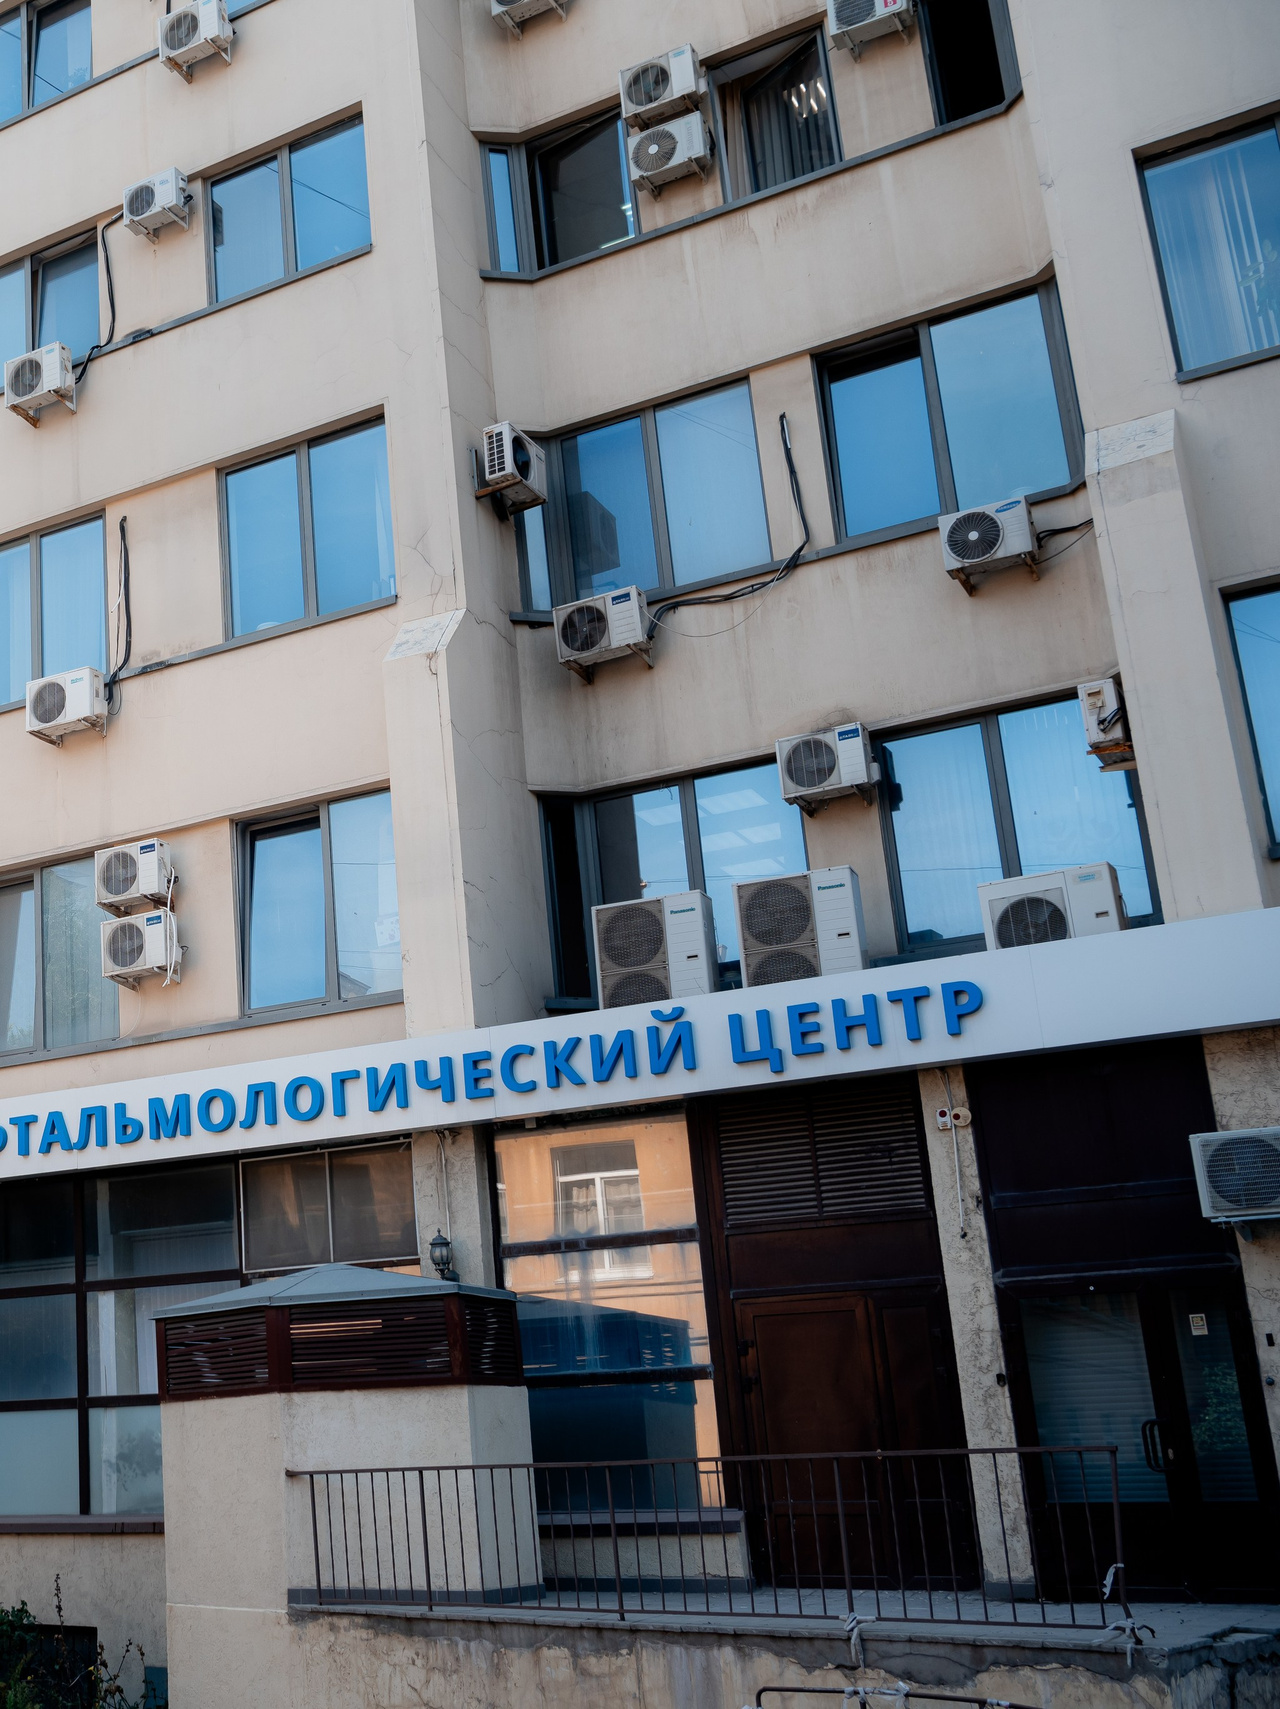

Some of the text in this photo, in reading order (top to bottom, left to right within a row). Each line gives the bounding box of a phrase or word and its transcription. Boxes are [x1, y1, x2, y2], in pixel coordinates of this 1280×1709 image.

[817, 882, 846, 891] Panasonic
[670, 907, 696, 915] Panasonic
[727, 980, 985, 1074] ЦЕНТР
